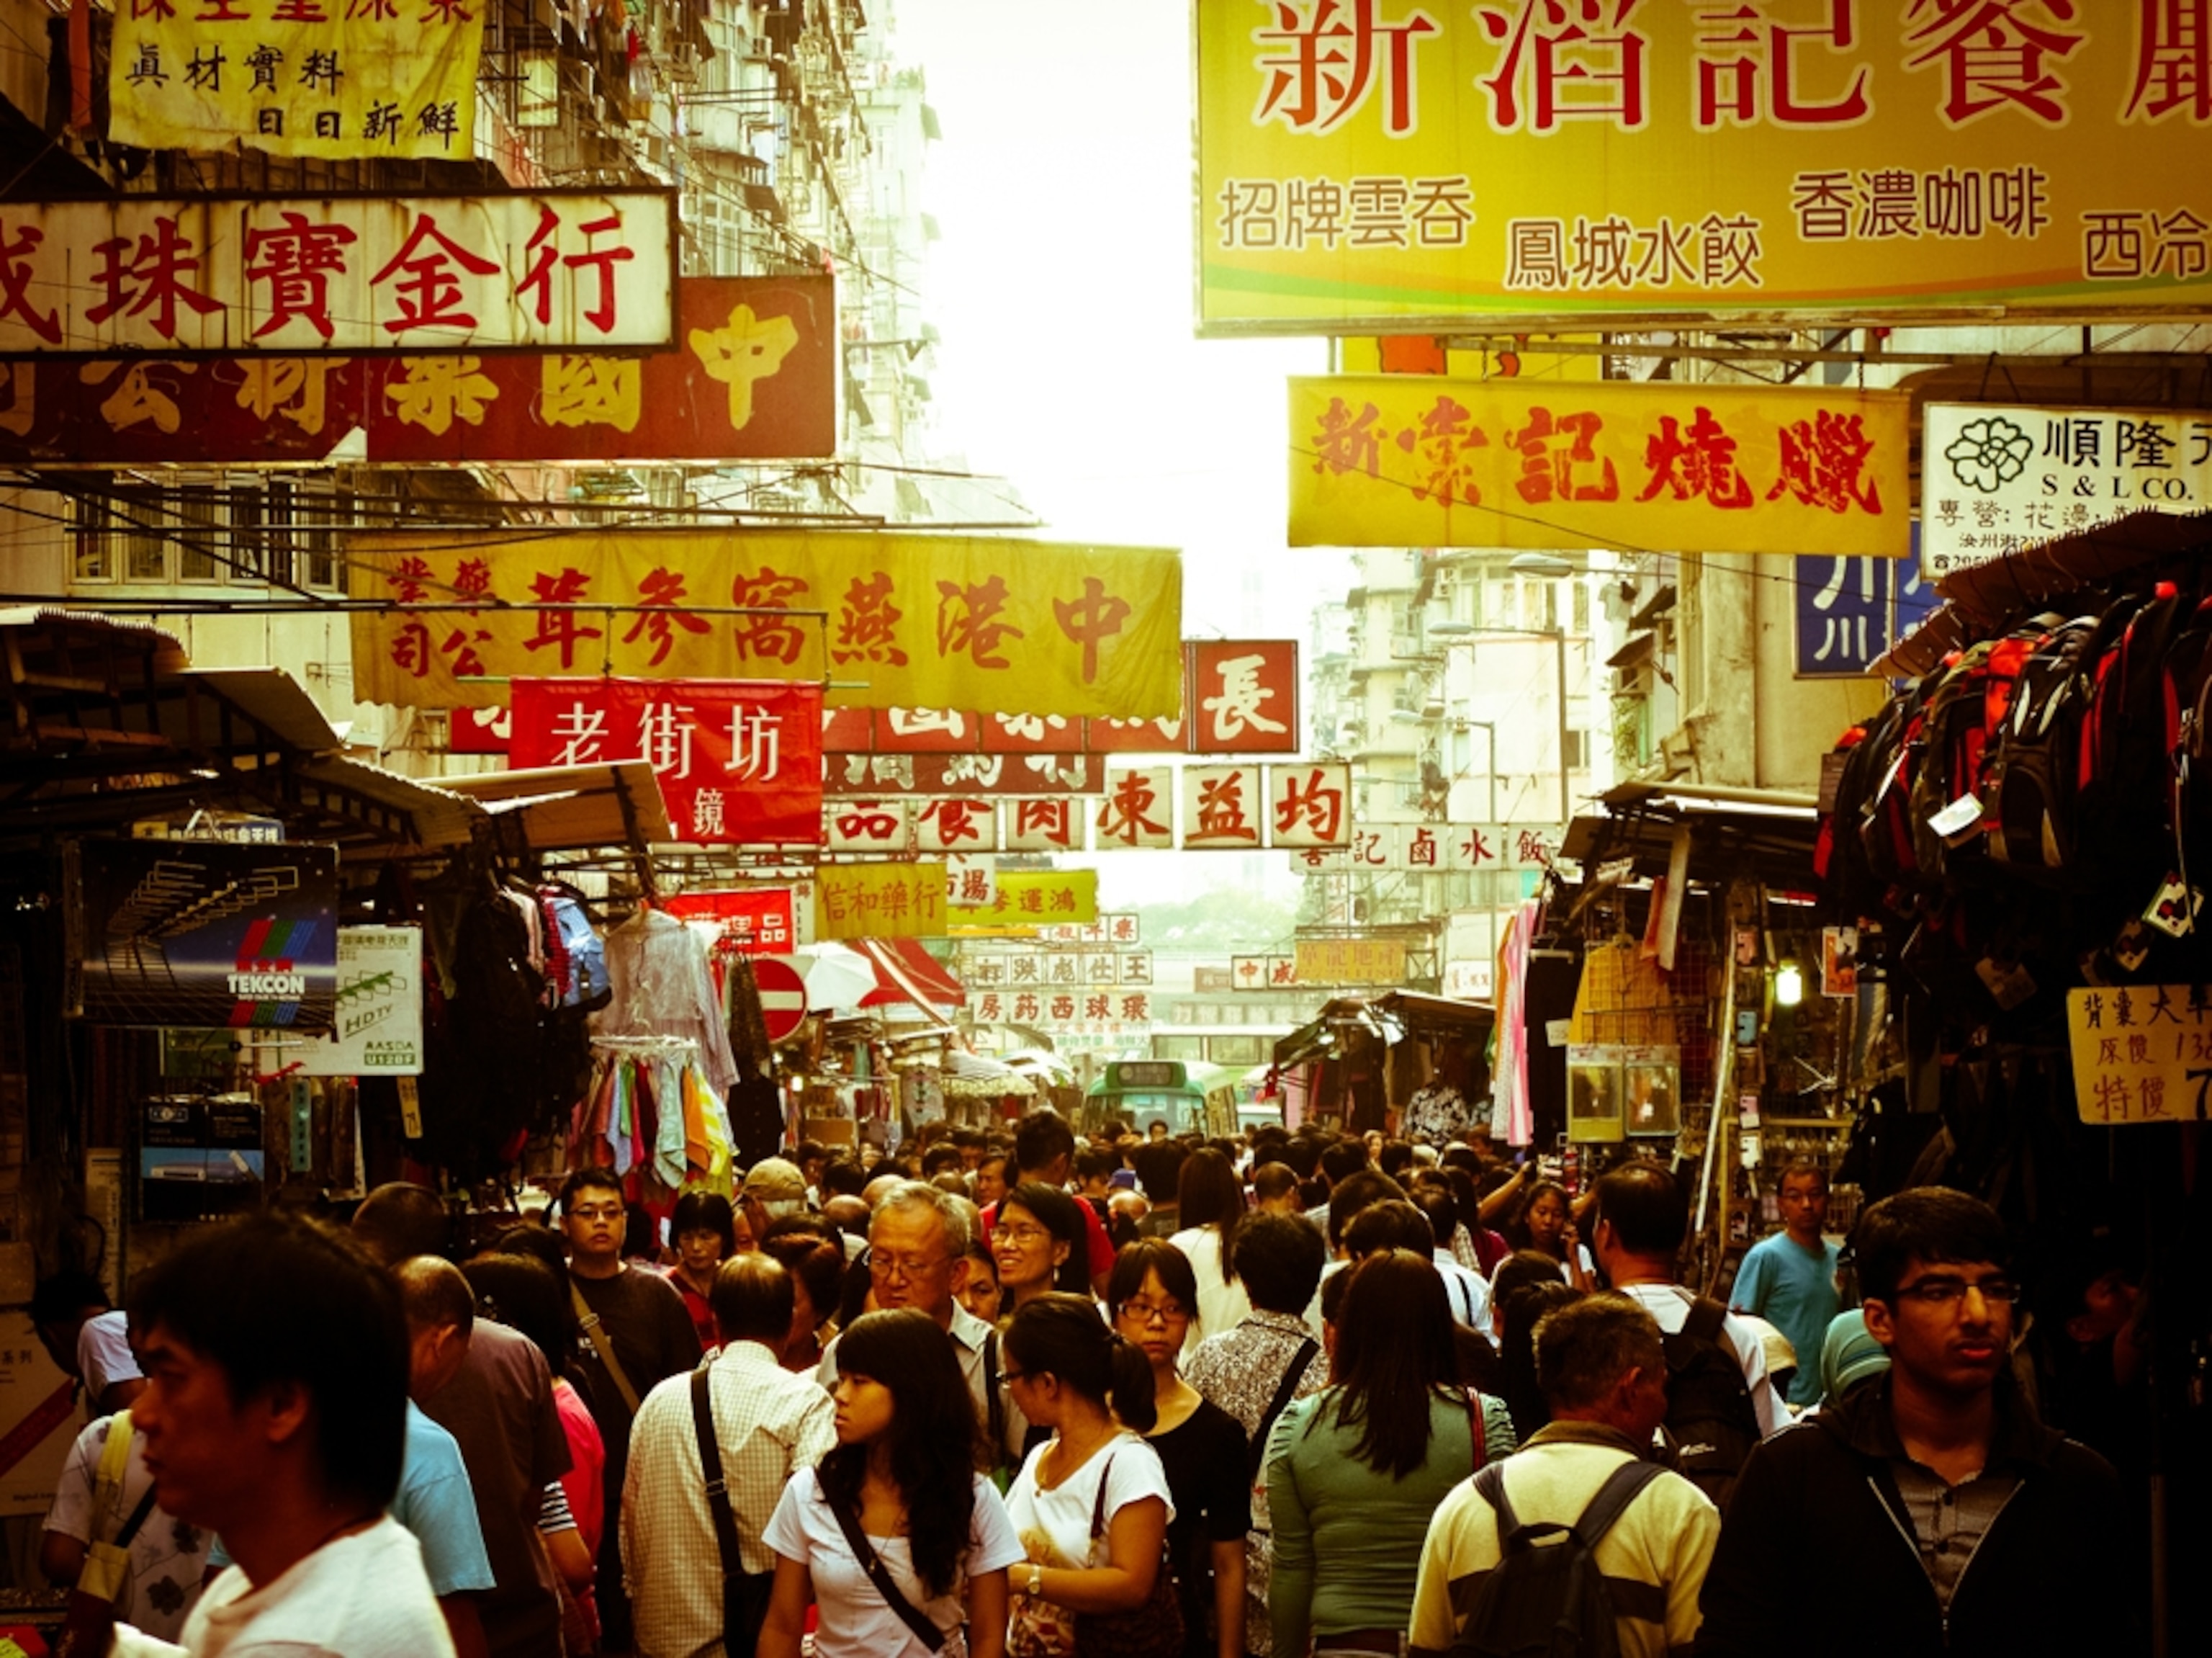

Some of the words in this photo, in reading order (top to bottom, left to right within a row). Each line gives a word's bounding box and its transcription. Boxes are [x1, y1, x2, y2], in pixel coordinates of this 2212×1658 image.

[258, 101, 459, 149] 日日新鮮
[1220, 179, 1473, 248] 招牌雲吞
[1794, 169, 2048, 238] 香濃咖啡
[1507, 215, 1761, 288] 鳳城水餃
[2041, 474, 2058, 497] S
[2072, 475, 2095, 497] &
[2111, 477, 2131, 498] L
[2143, 478, 2194, 501] CO.
[551, 702, 783, 781] 老街坊
[227, 974, 305, 994] TEKCON
[345, 1004, 393, 1033] HDTV
